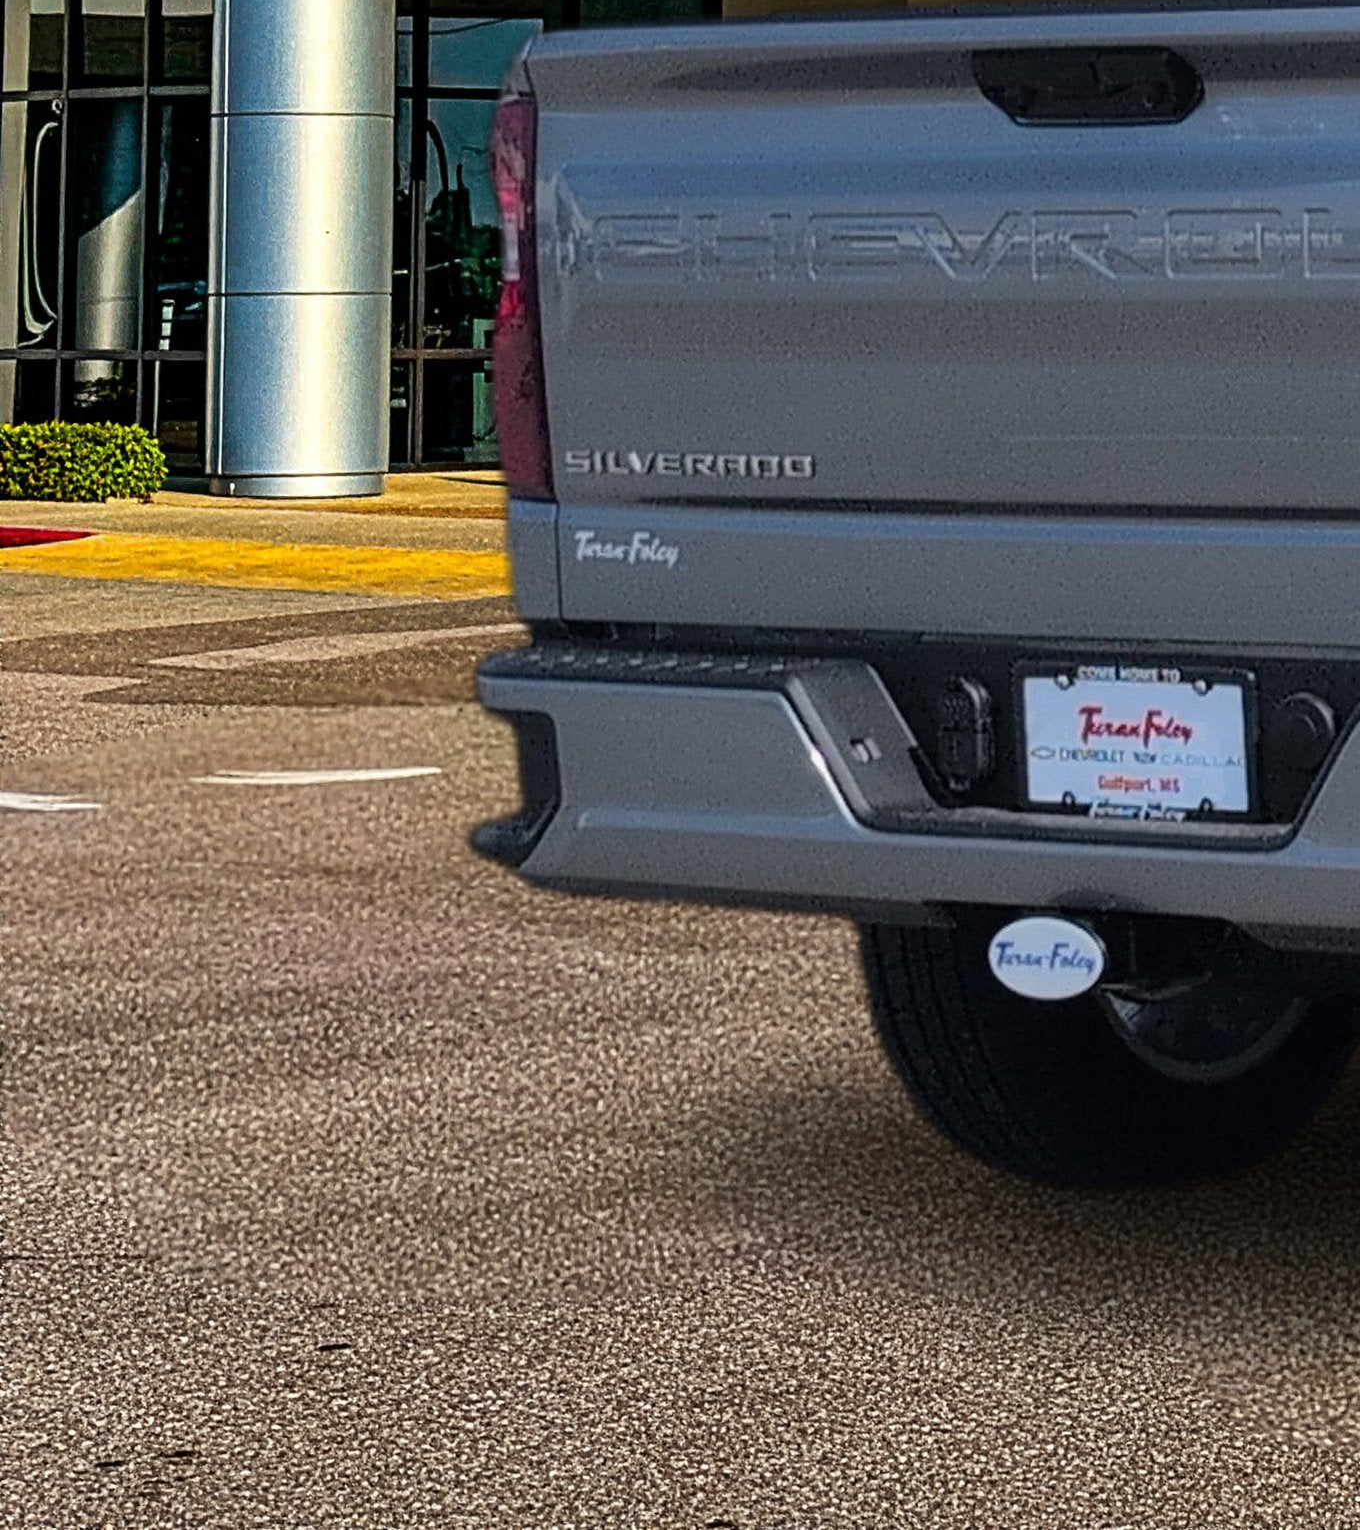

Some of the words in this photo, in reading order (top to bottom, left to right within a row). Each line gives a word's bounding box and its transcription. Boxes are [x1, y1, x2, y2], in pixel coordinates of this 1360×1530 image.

[564, 449, 816, 478] SILVERADO
[1078, 706, 1141, 745] Turan
[1142, 709, 1194, 748] Foley
[1059, 746, 1125, 764] CHEVROLET
[1049, 941, 1096, 977] Foley
